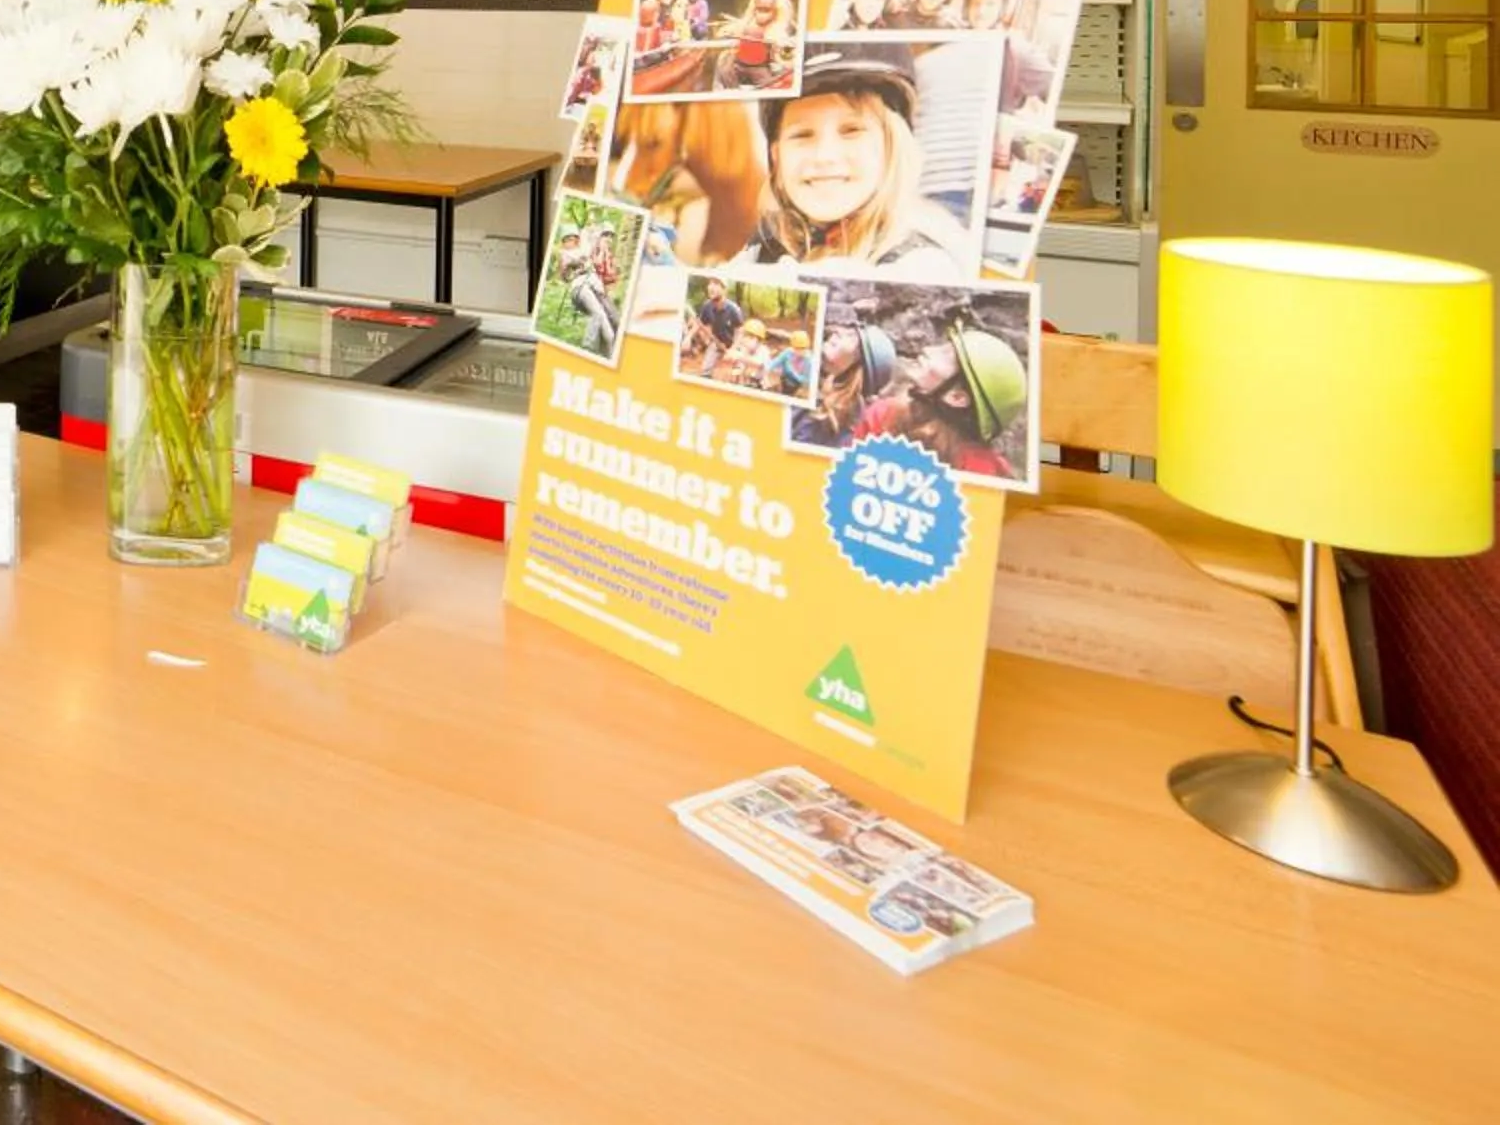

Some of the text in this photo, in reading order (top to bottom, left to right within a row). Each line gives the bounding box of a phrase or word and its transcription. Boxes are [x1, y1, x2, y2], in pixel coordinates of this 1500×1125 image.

[1312, 127, 1428, 151] KITCHEN
[550, 368, 754, 470] Make it a
[541, 426, 795, 539] summer to
[851, 453, 941, 508] 20%
[535, 471, 788, 600] remember.
[851, 492, 936, 544] OFF
[817, 675, 867, 713] yha
